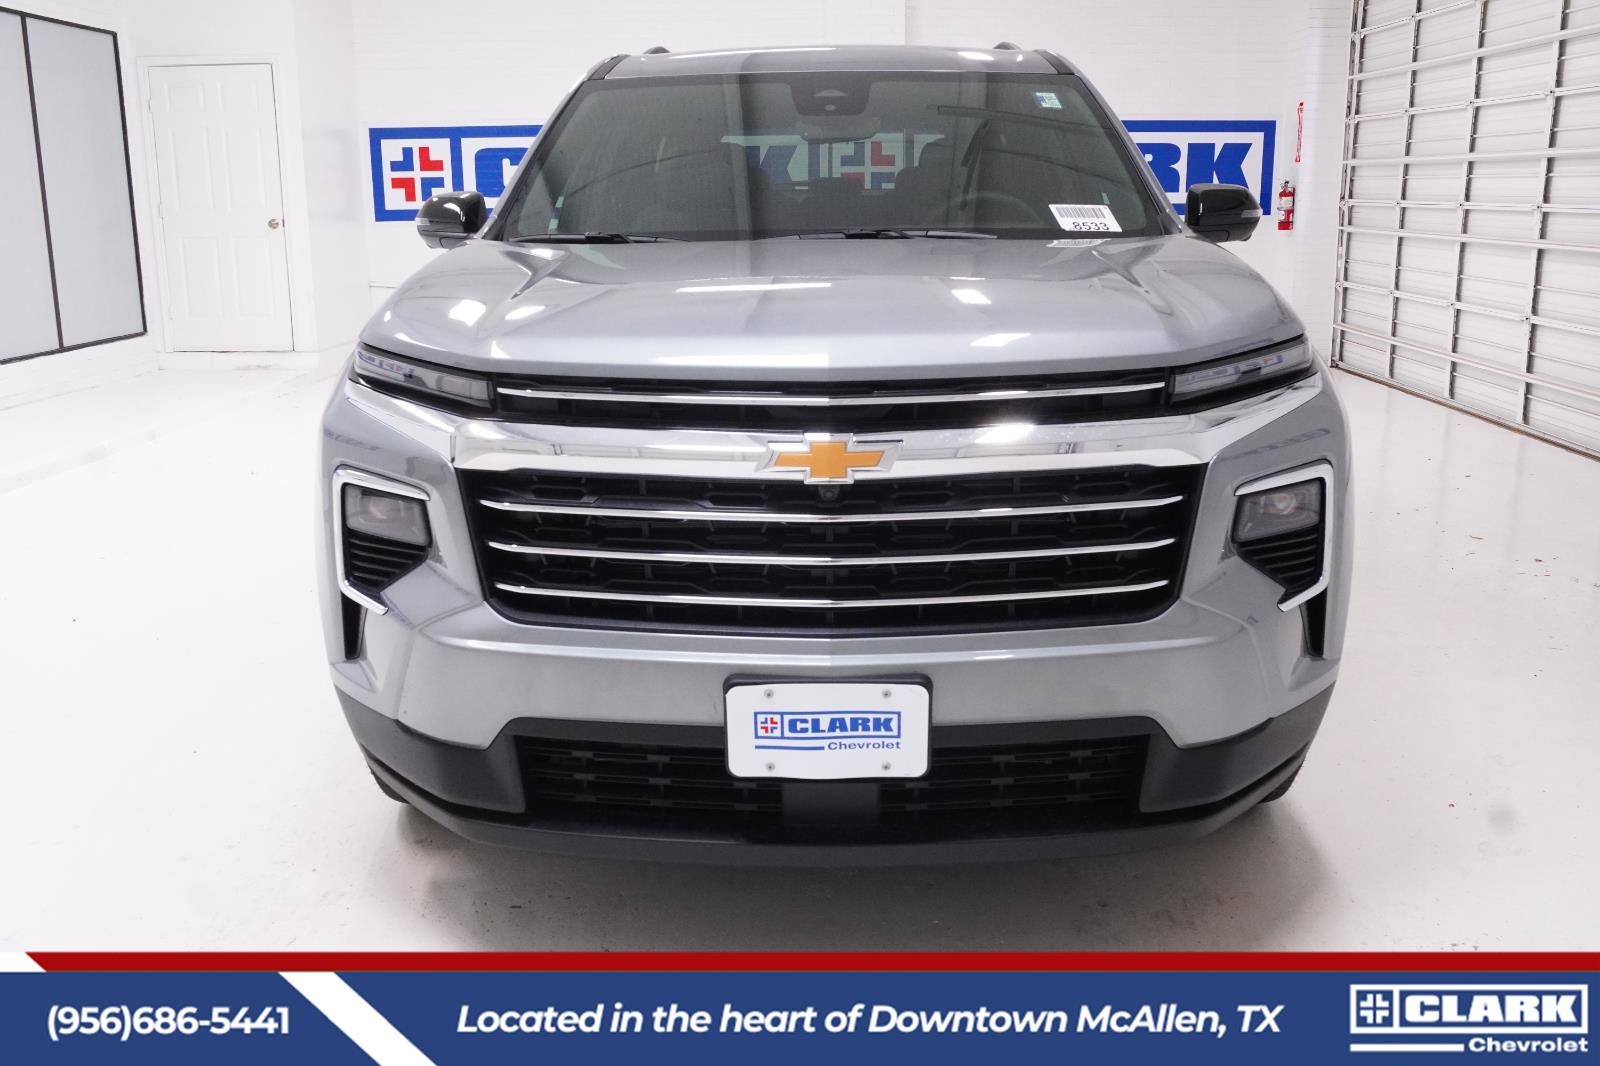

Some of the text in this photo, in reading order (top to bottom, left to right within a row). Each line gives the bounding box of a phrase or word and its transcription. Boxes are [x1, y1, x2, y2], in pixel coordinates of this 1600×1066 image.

[1072, 221, 1110, 231] 8533
[788, 717, 894, 734] CLARK
[827, 741, 901, 751] Chevrolet
